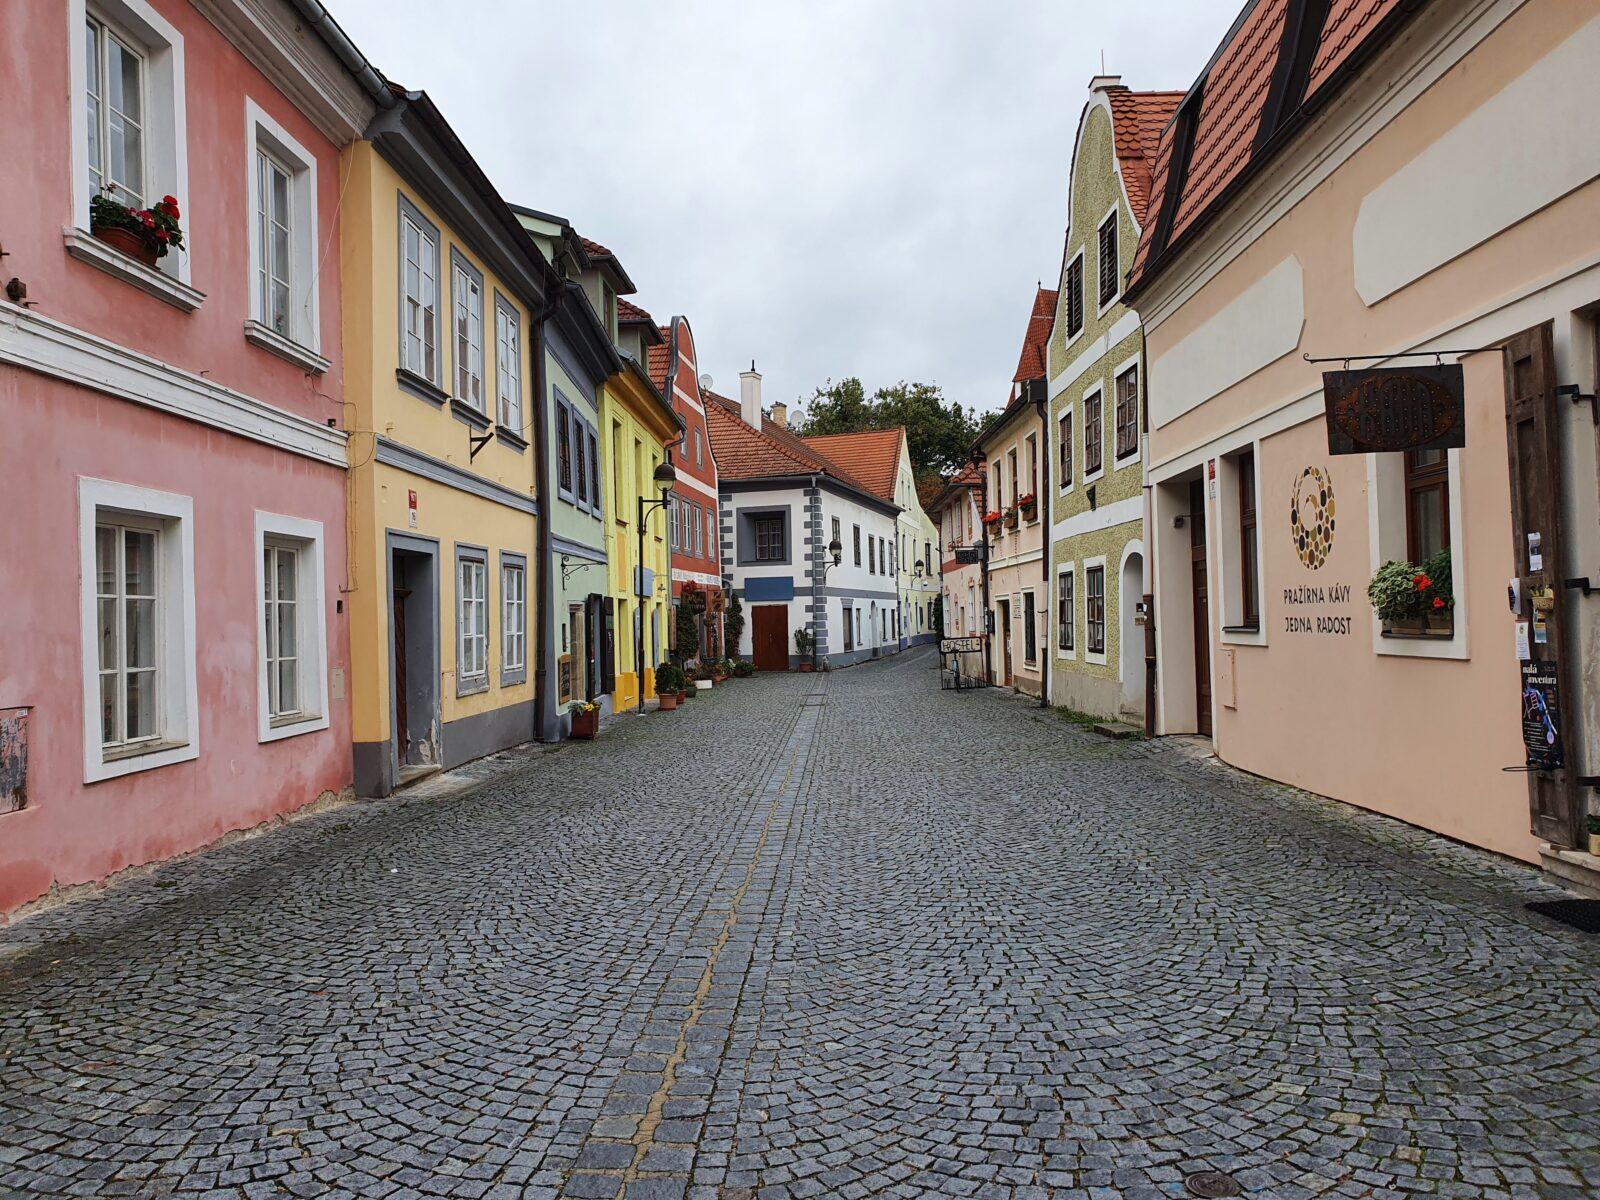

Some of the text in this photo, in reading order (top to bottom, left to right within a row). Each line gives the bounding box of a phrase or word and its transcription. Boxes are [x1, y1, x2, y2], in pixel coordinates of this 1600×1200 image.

[1283, 582, 1351, 605] PRAŽÍRNA KÁVY
[1285, 616, 1352, 635] JEDNA RADOST
